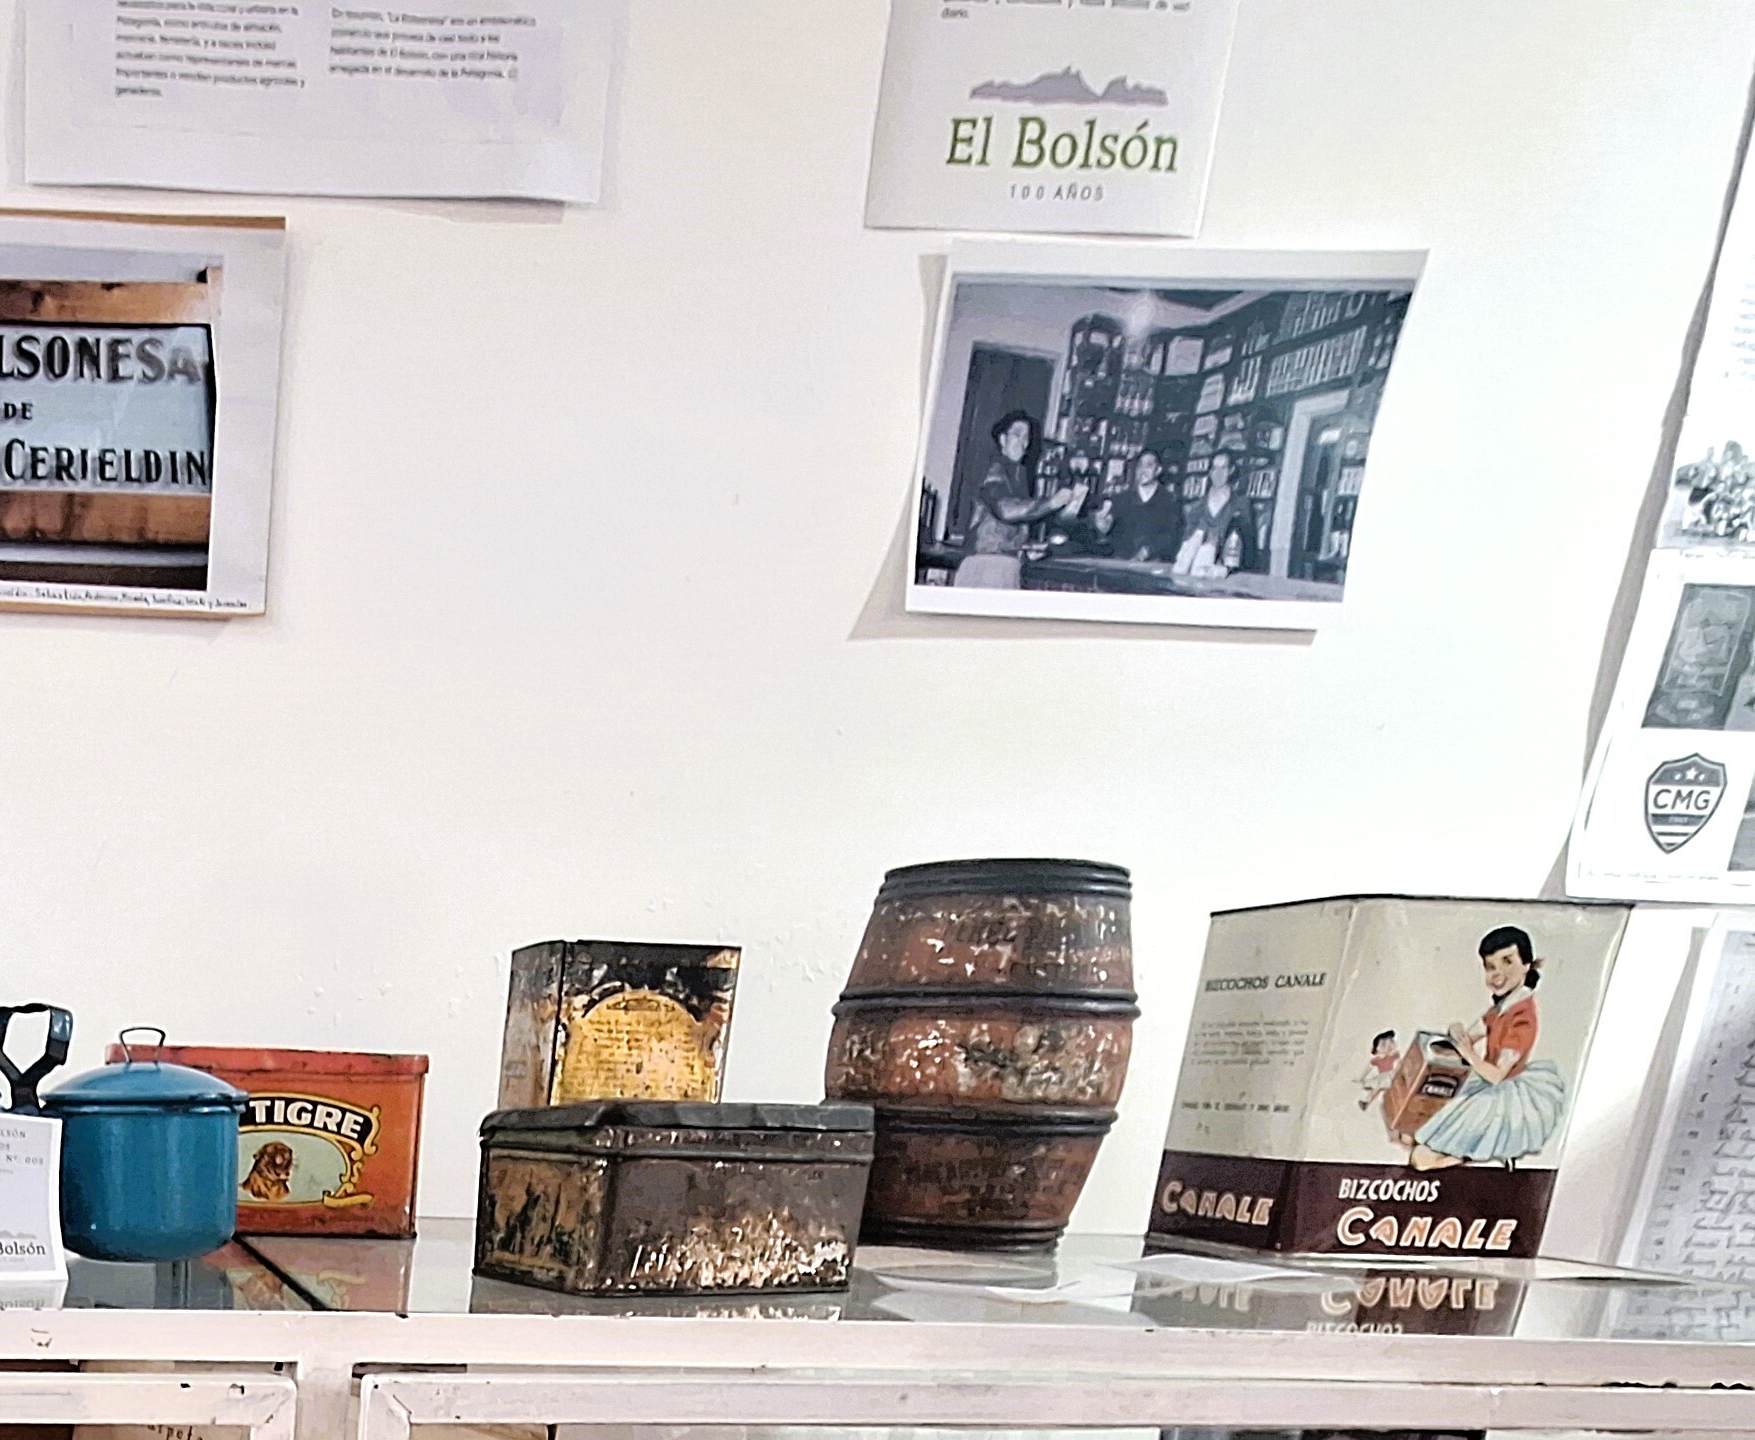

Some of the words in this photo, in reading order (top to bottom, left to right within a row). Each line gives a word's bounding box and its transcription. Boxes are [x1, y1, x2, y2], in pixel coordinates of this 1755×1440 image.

[947, 115, 994, 166] El
[1011, 115, 1179, 173] Bolsón
[1010, 183, 1045, 200] 100
[1053, 182, 1104, 201] AÑOS
[3, 401, 33, 421] DE
[3, 439, 209, 486] CERIELDIN
[1653, 788, 1711, 811] CMG
[1275, 972, 1326, 988] CANALE
[249, 1100, 365, 1139] TIGRE
[1338, 1179, 1440, 1203] BIZCOCHOS
[1161, 1181, 1275, 1226] CANALE
[1336, 1207, 1519, 1251] CANALE
